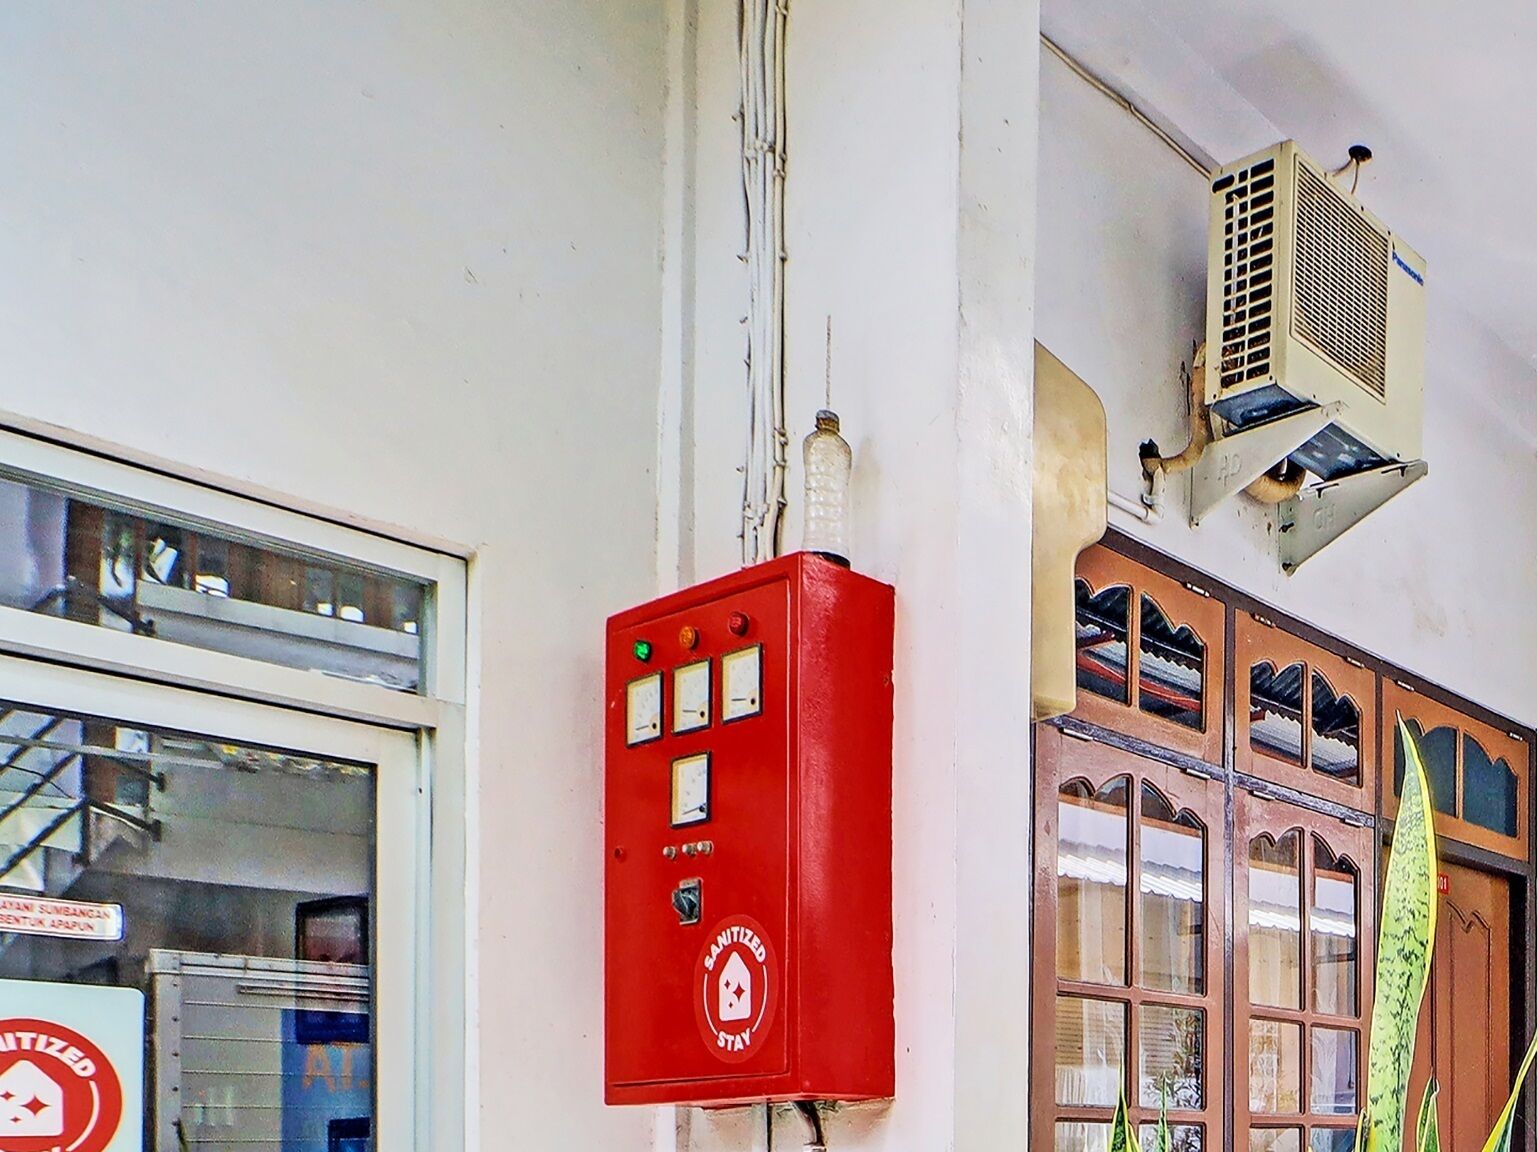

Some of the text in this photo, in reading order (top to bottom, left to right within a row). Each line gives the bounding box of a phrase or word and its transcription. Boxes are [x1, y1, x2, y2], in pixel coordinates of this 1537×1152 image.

[0, 901, 111, 920] AYANI SUMBANGAN
[51, 919, 95, 931] APAPUN
[704, 926, 766, 971] SANITIZED
[717, 1028, 751, 1052] STAY
